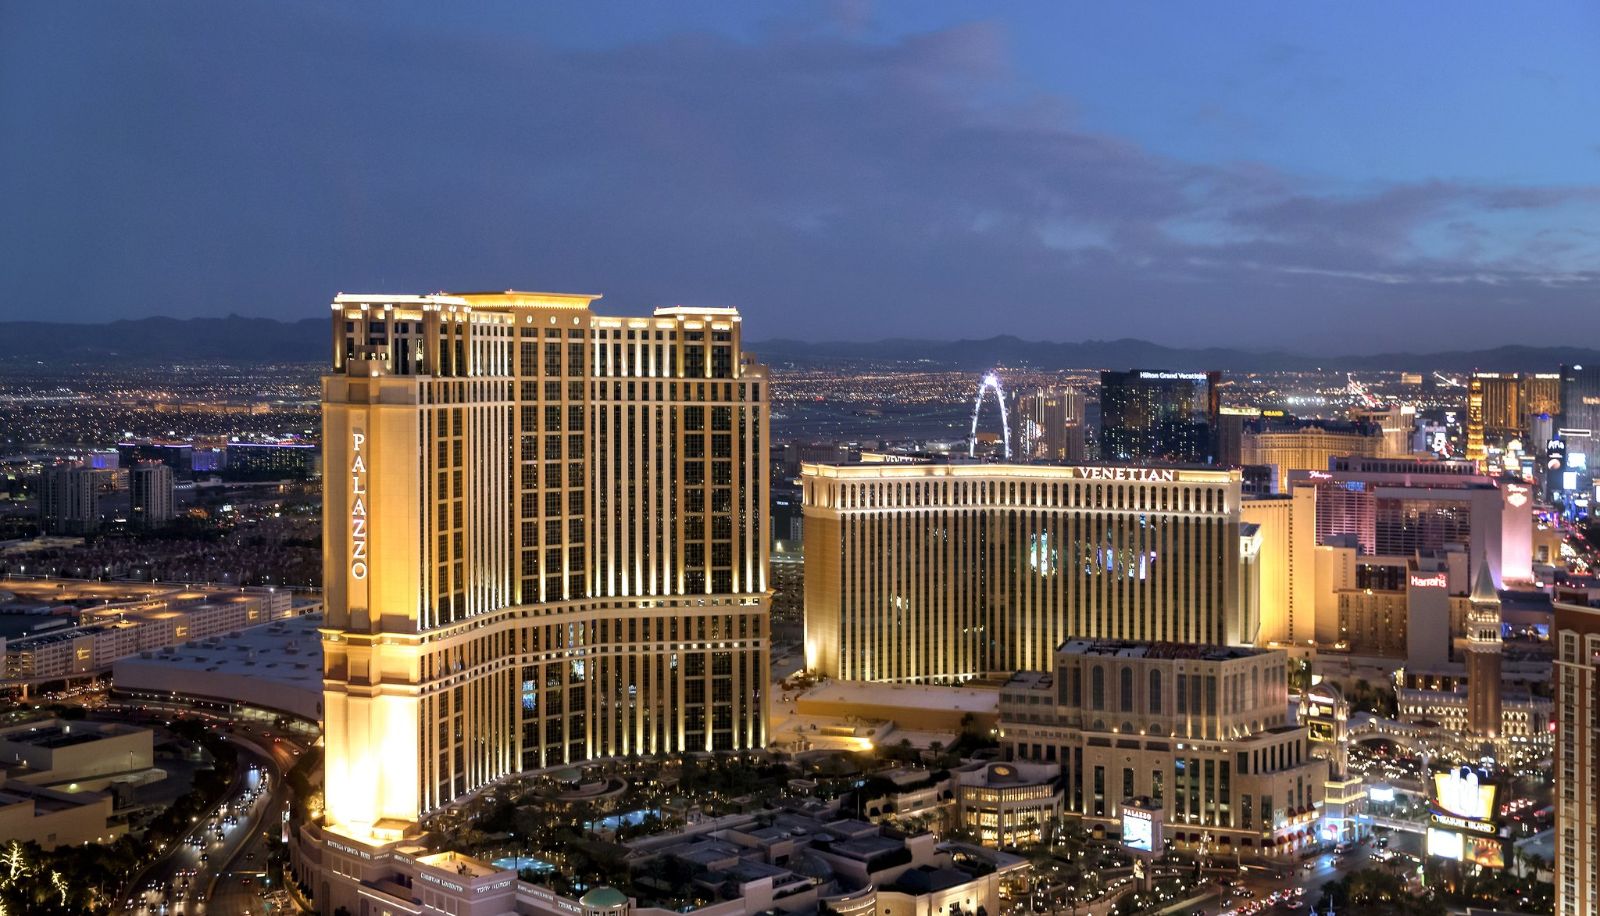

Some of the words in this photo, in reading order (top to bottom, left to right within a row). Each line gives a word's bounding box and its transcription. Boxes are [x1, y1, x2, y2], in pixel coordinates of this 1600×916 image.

[1077, 466, 1175, 482] VENETIAN
[351, 433, 368, 580] PALAZZO
[1123, 808, 1152, 821] PALAZZO
